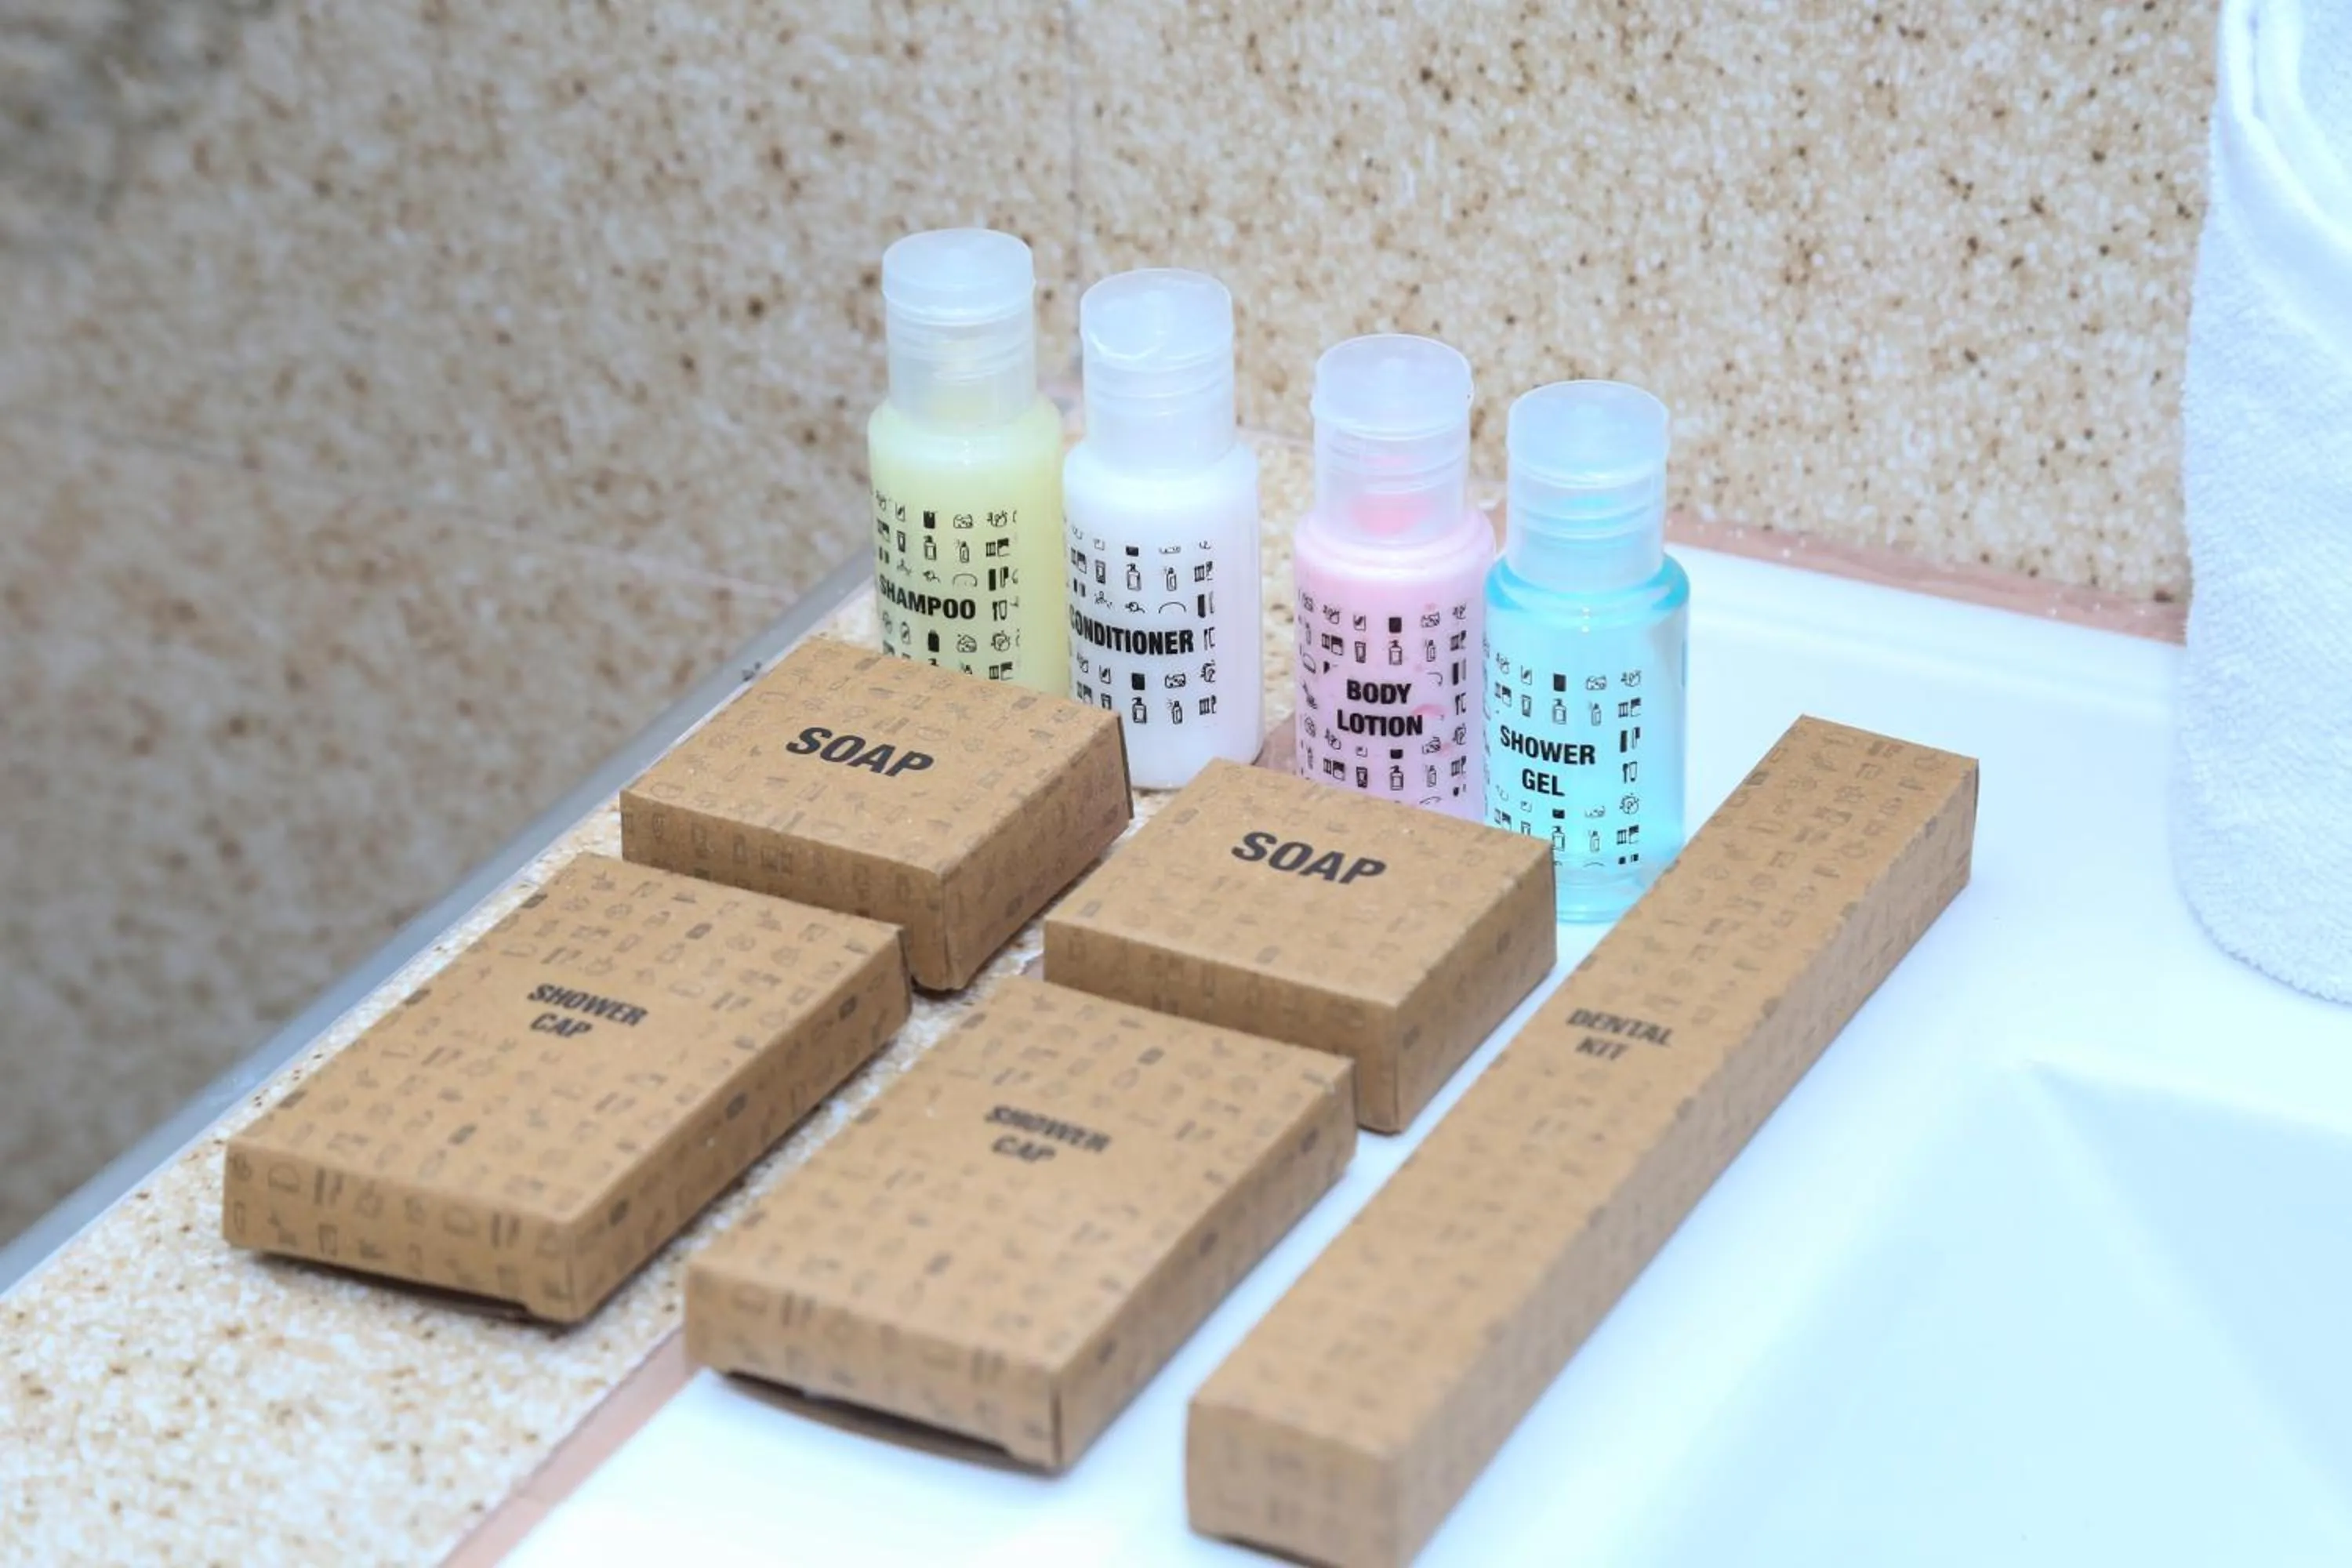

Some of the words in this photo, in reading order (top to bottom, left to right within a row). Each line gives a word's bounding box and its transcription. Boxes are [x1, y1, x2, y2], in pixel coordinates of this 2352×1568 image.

[879, 575, 976, 620] SHAMPOO
[1069, 604, 1194, 655] CONDITIONER
[1346, 680, 1412, 705] BODY
[1336, 709, 1424, 737] LOTION
[786, 727, 935, 777] SOAP
[1499, 725, 1596, 766] SHOWER
[1522, 768, 1565, 797] GEL
[1231, 831, 1387, 884] SOAP
[526, 983, 649, 1027] SHOWER
[529, 1012, 593, 1038] CAP
[1566, 1007, 1673, 1047] DENTAL
[1575, 1035, 1630, 1061] KIT
[984, 1105, 1112, 1153] SHOWER
[991, 1134, 1057, 1163] CAP
